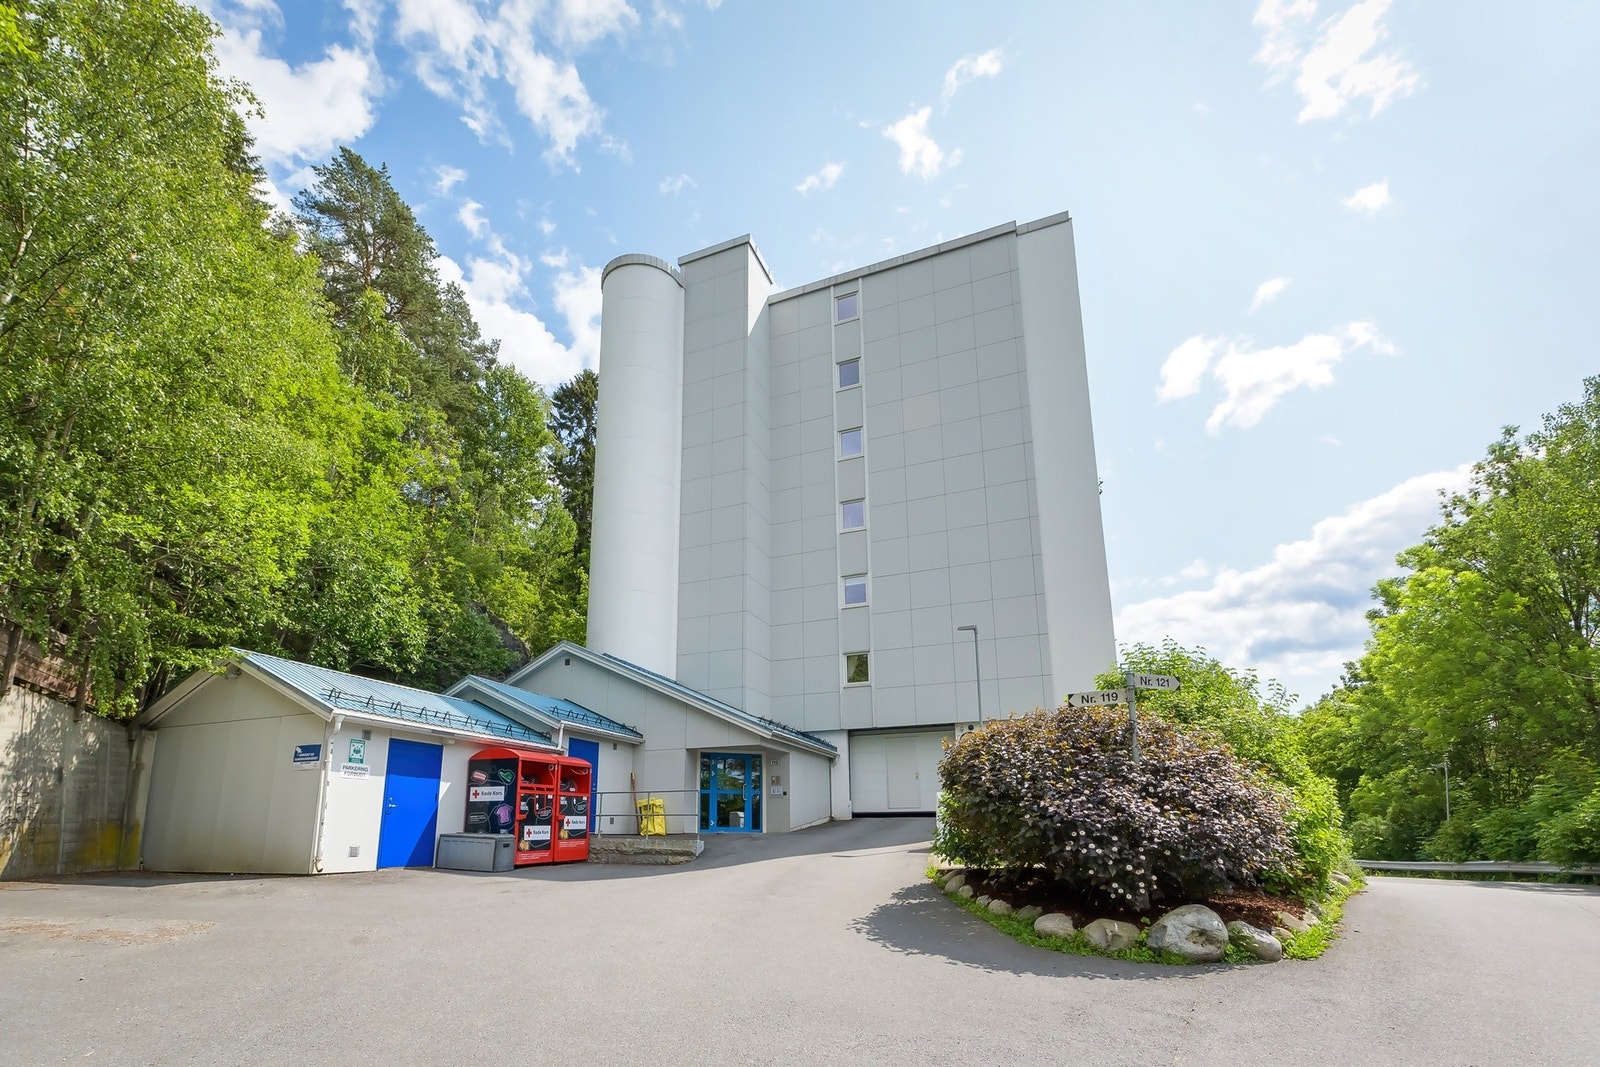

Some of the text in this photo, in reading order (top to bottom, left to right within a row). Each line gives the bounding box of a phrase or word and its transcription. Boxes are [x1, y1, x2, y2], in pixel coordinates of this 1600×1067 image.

[1140, 676, 1170, 687] Nr. 121
[1081, 692, 1118, 704] Nr. 119
[342, 764, 369, 772] PARKERING
